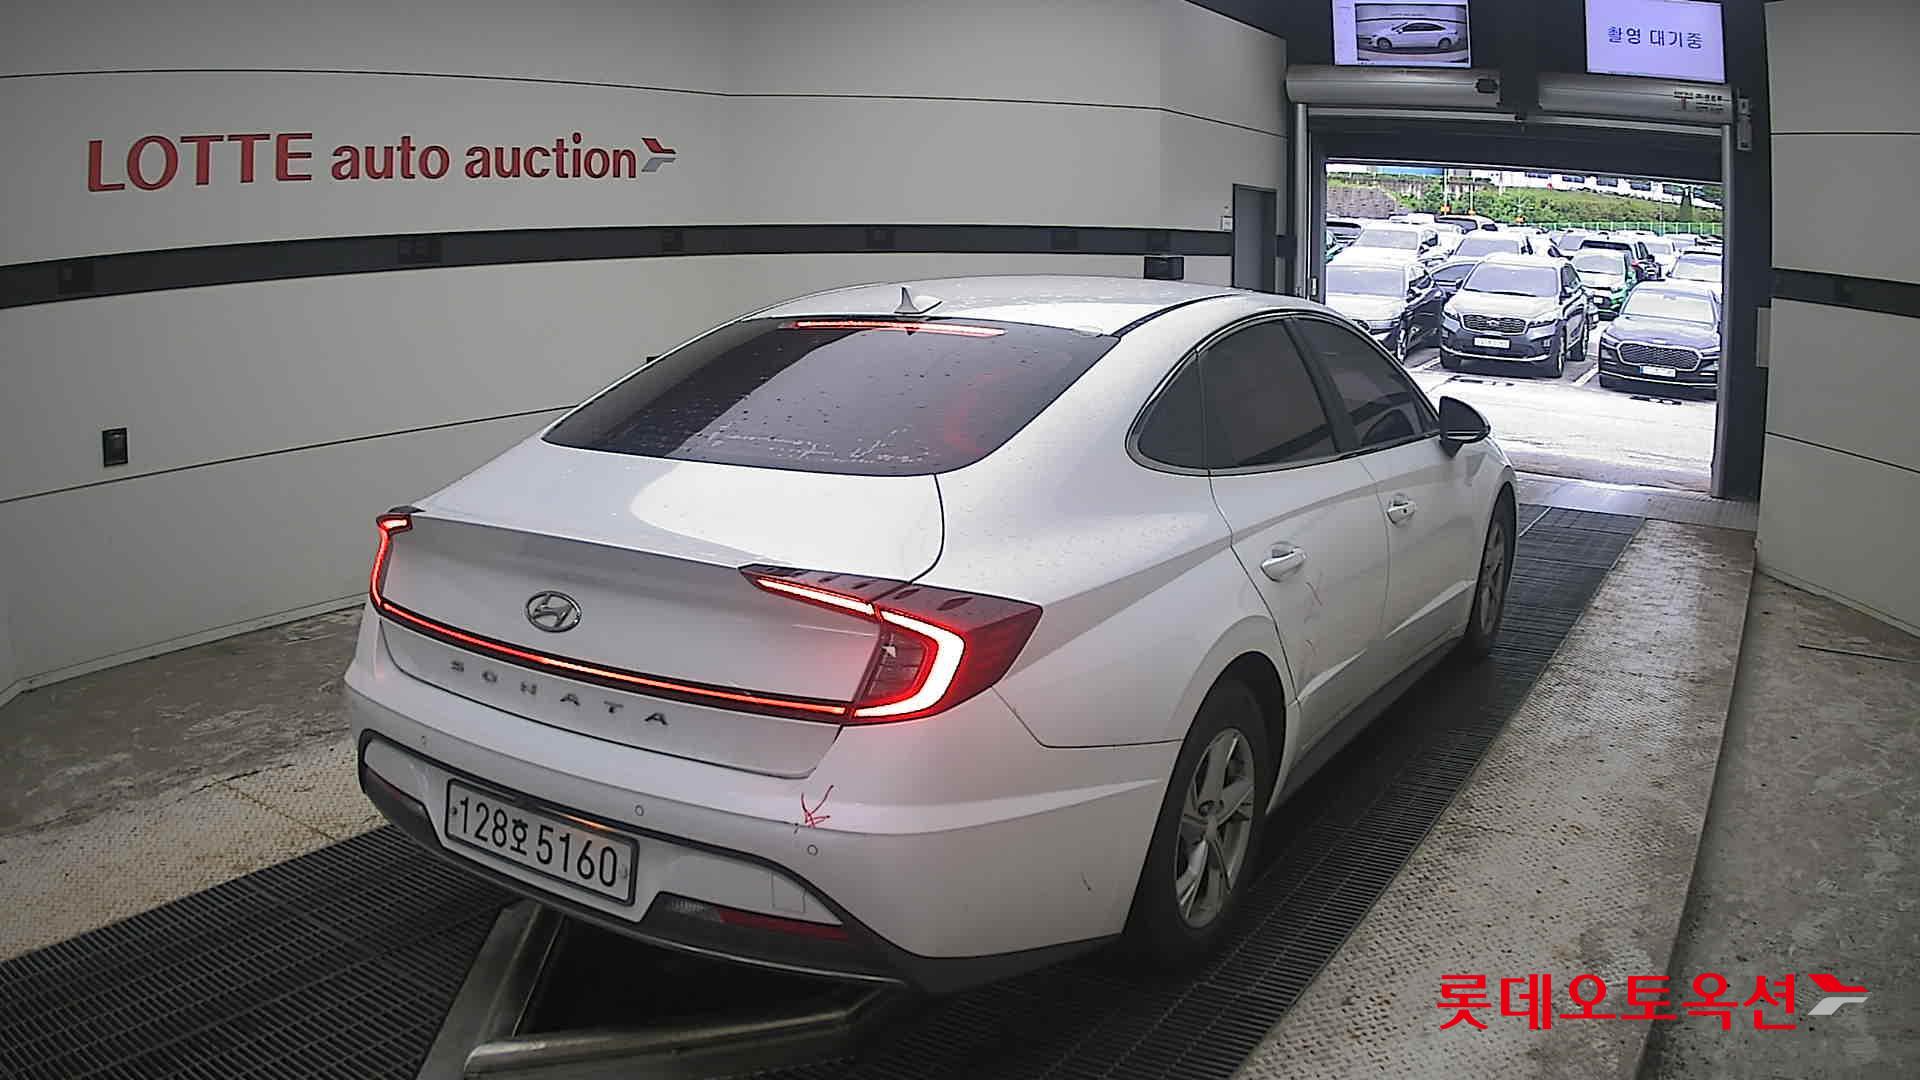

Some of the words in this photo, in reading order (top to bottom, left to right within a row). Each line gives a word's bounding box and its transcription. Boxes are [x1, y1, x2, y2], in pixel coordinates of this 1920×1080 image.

[1649, 29, 1703, 49] 대기중
[88, 132, 313, 193] LOTTE
[331, 135, 450, 181] auto
[464, 131, 638, 180] auction
[450, 659, 669, 727] SONATA
